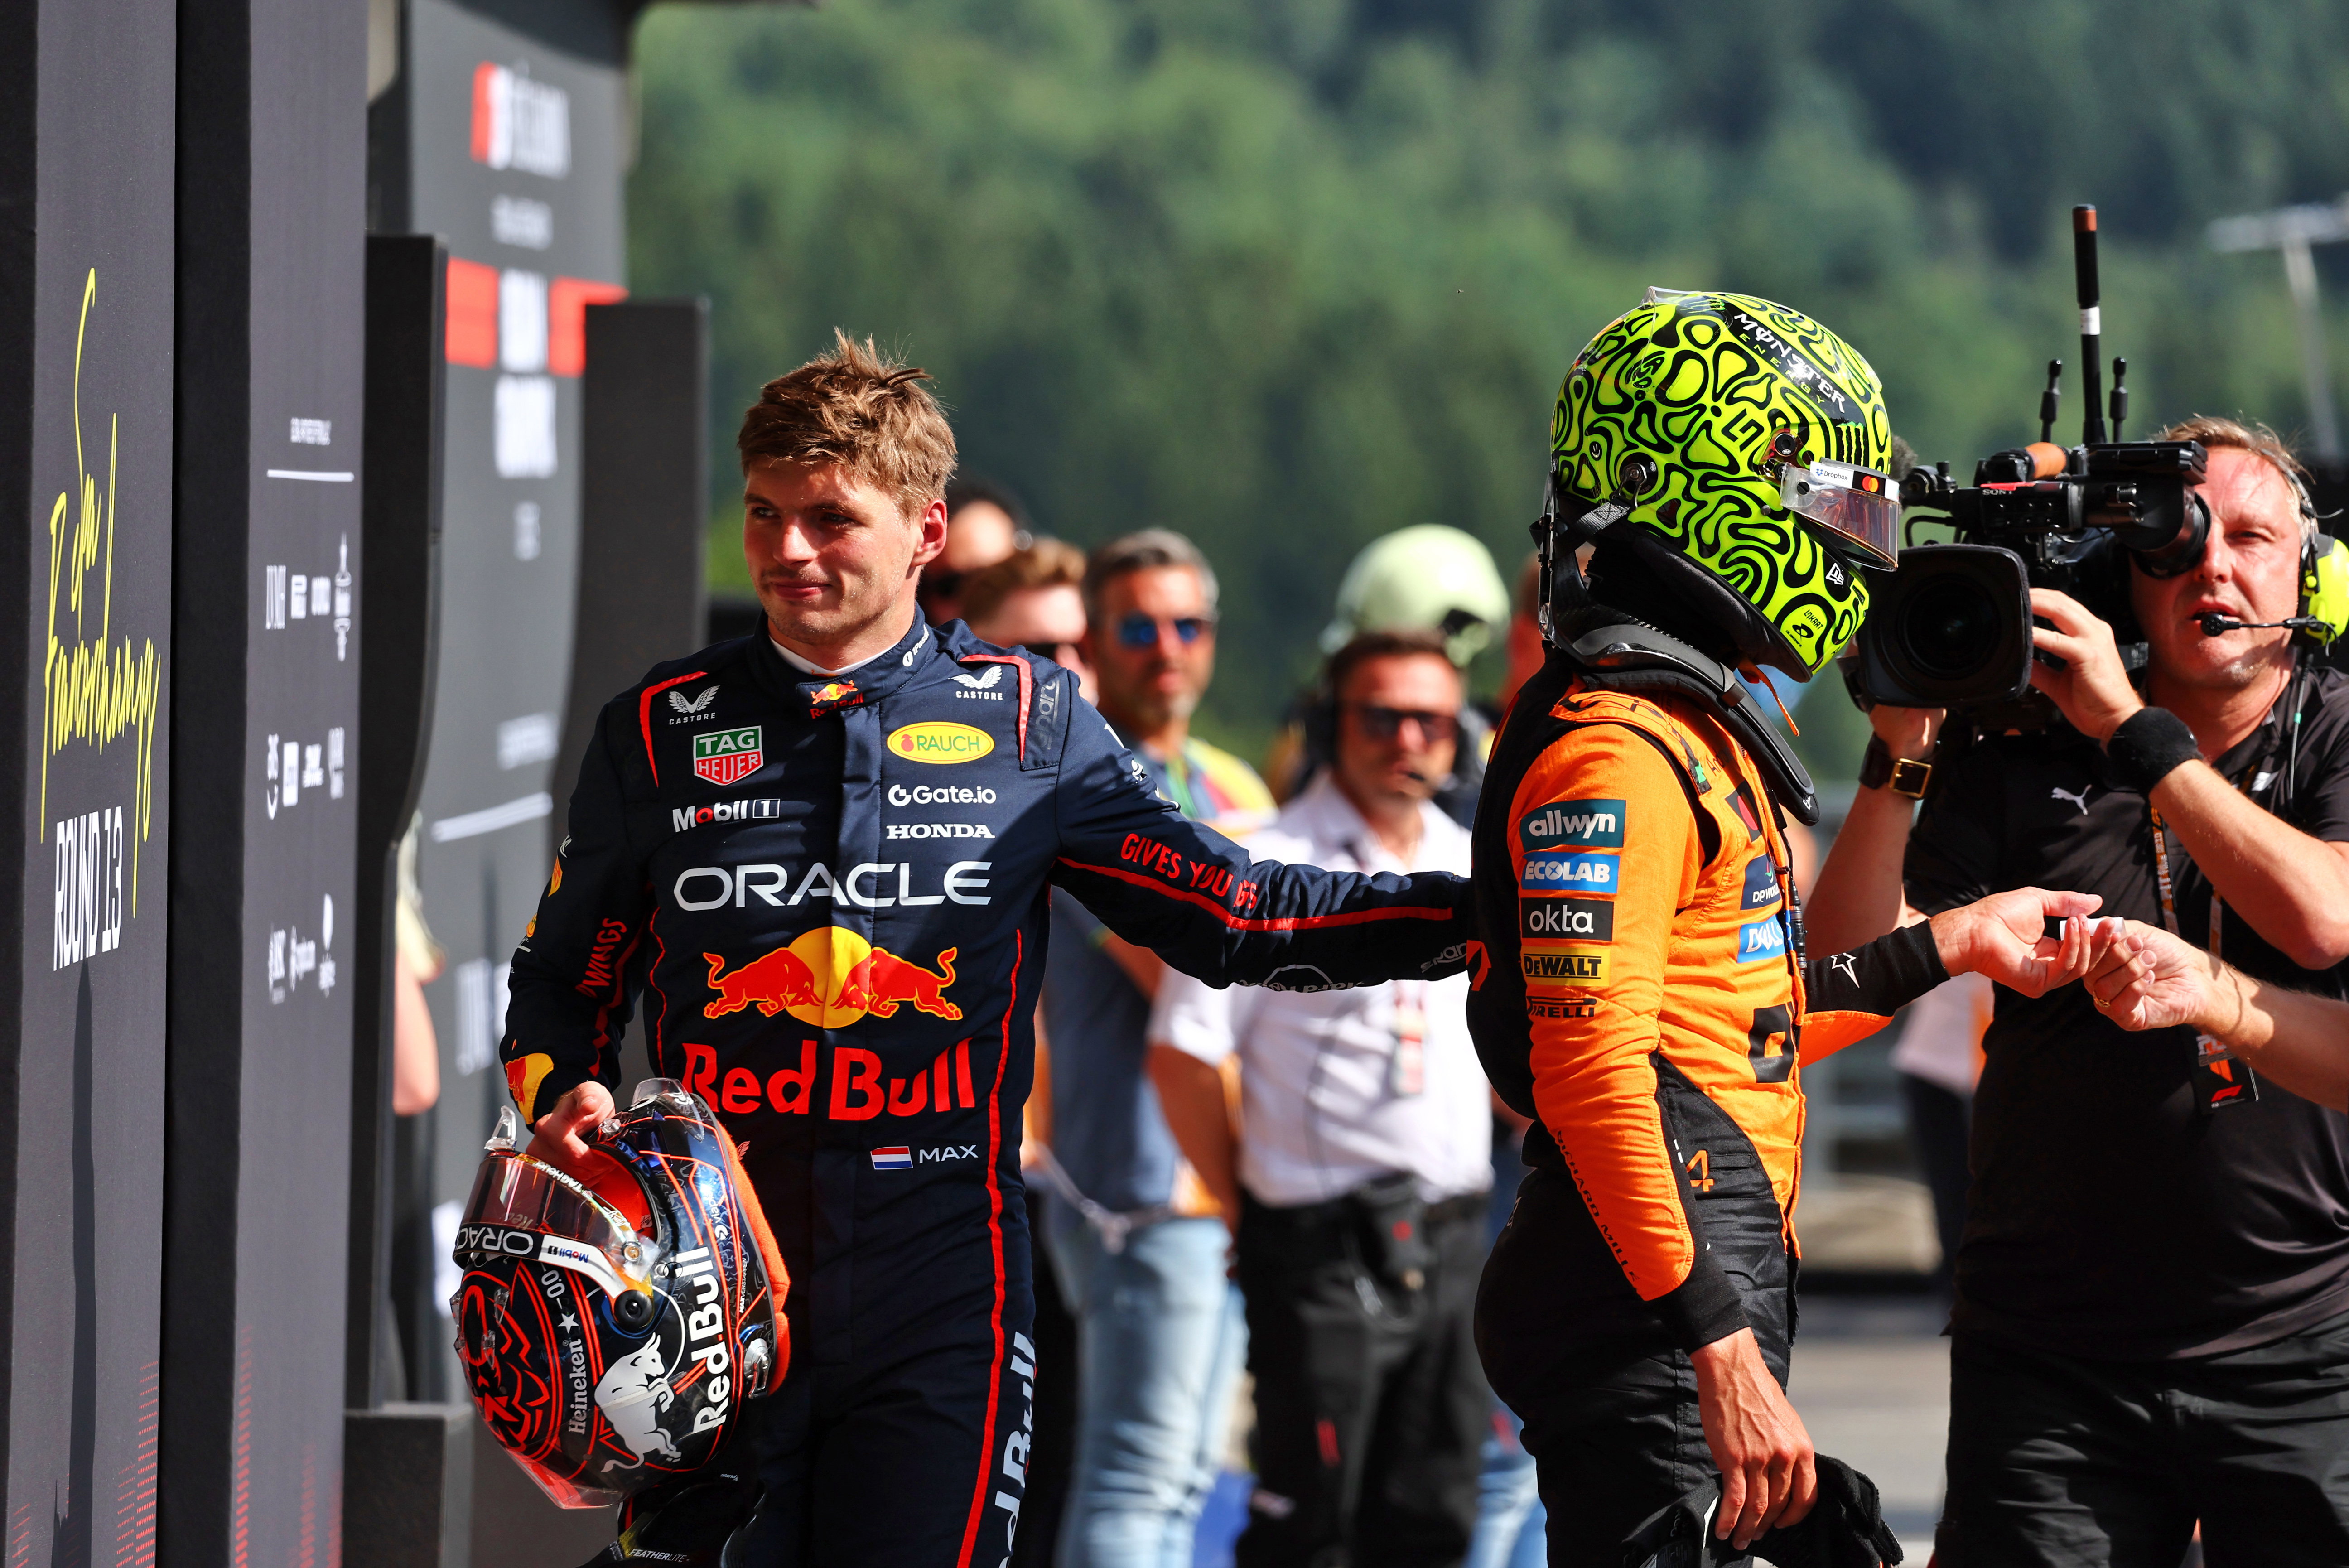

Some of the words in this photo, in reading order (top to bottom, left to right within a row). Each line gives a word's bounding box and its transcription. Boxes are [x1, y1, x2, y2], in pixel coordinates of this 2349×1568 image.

[1739, 333, 1825, 404] ENERGY
[1824, 471, 1847, 481] Dropbox
[912, 624, 929, 656] 1Pass
[810, 702, 837, 719] Red
[839, 693, 864, 707] Bull
[956, 691, 1003, 700] CASTORE
[669, 712, 716, 725] CASTORE
[1036, 680, 1056, 748] sparc
[699, 731, 755, 754] TAG
[917, 736, 980, 752] RAUCH
[699, 753, 758, 783] HEUER
[913, 786, 996, 804] Gate.io
[672, 800, 748, 833] Mobil
[1529, 809, 1616, 839] allwyn
[886, 824, 995, 839] HONDA
[1120, 833, 1181, 879] GIVES
[1190, 860, 1234, 897] YOU
[1525, 861, 1611, 883] ECOLAB
[53, 811, 100, 971] ROUND
[102, 806, 122, 953] 13
[674, 861, 993, 912] ORACLE
[1752, 889, 1765, 903] DP
[1529, 904, 1594, 934] okta
[1420, 942, 1467, 970] spar
[681, 1039, 818, 1115] Red
[829, 1037, 975, 1121] Bull
[919, 1144, 979, 1164] MAX
[1685, 1149, 1714, 1192] 4
[456, 1227, 534, 1255] ORAC
[559, 1247, 589, 1263] Mobil
[541, 1269, 565, 1298] 0.0
[670, 1246, 724, 1341] Bull
[569, 1338, 587, 1435] Heineken
[691, 1341, 730, 1434] Red
[629, 1549, 687, 1563] FEATHERLITE
